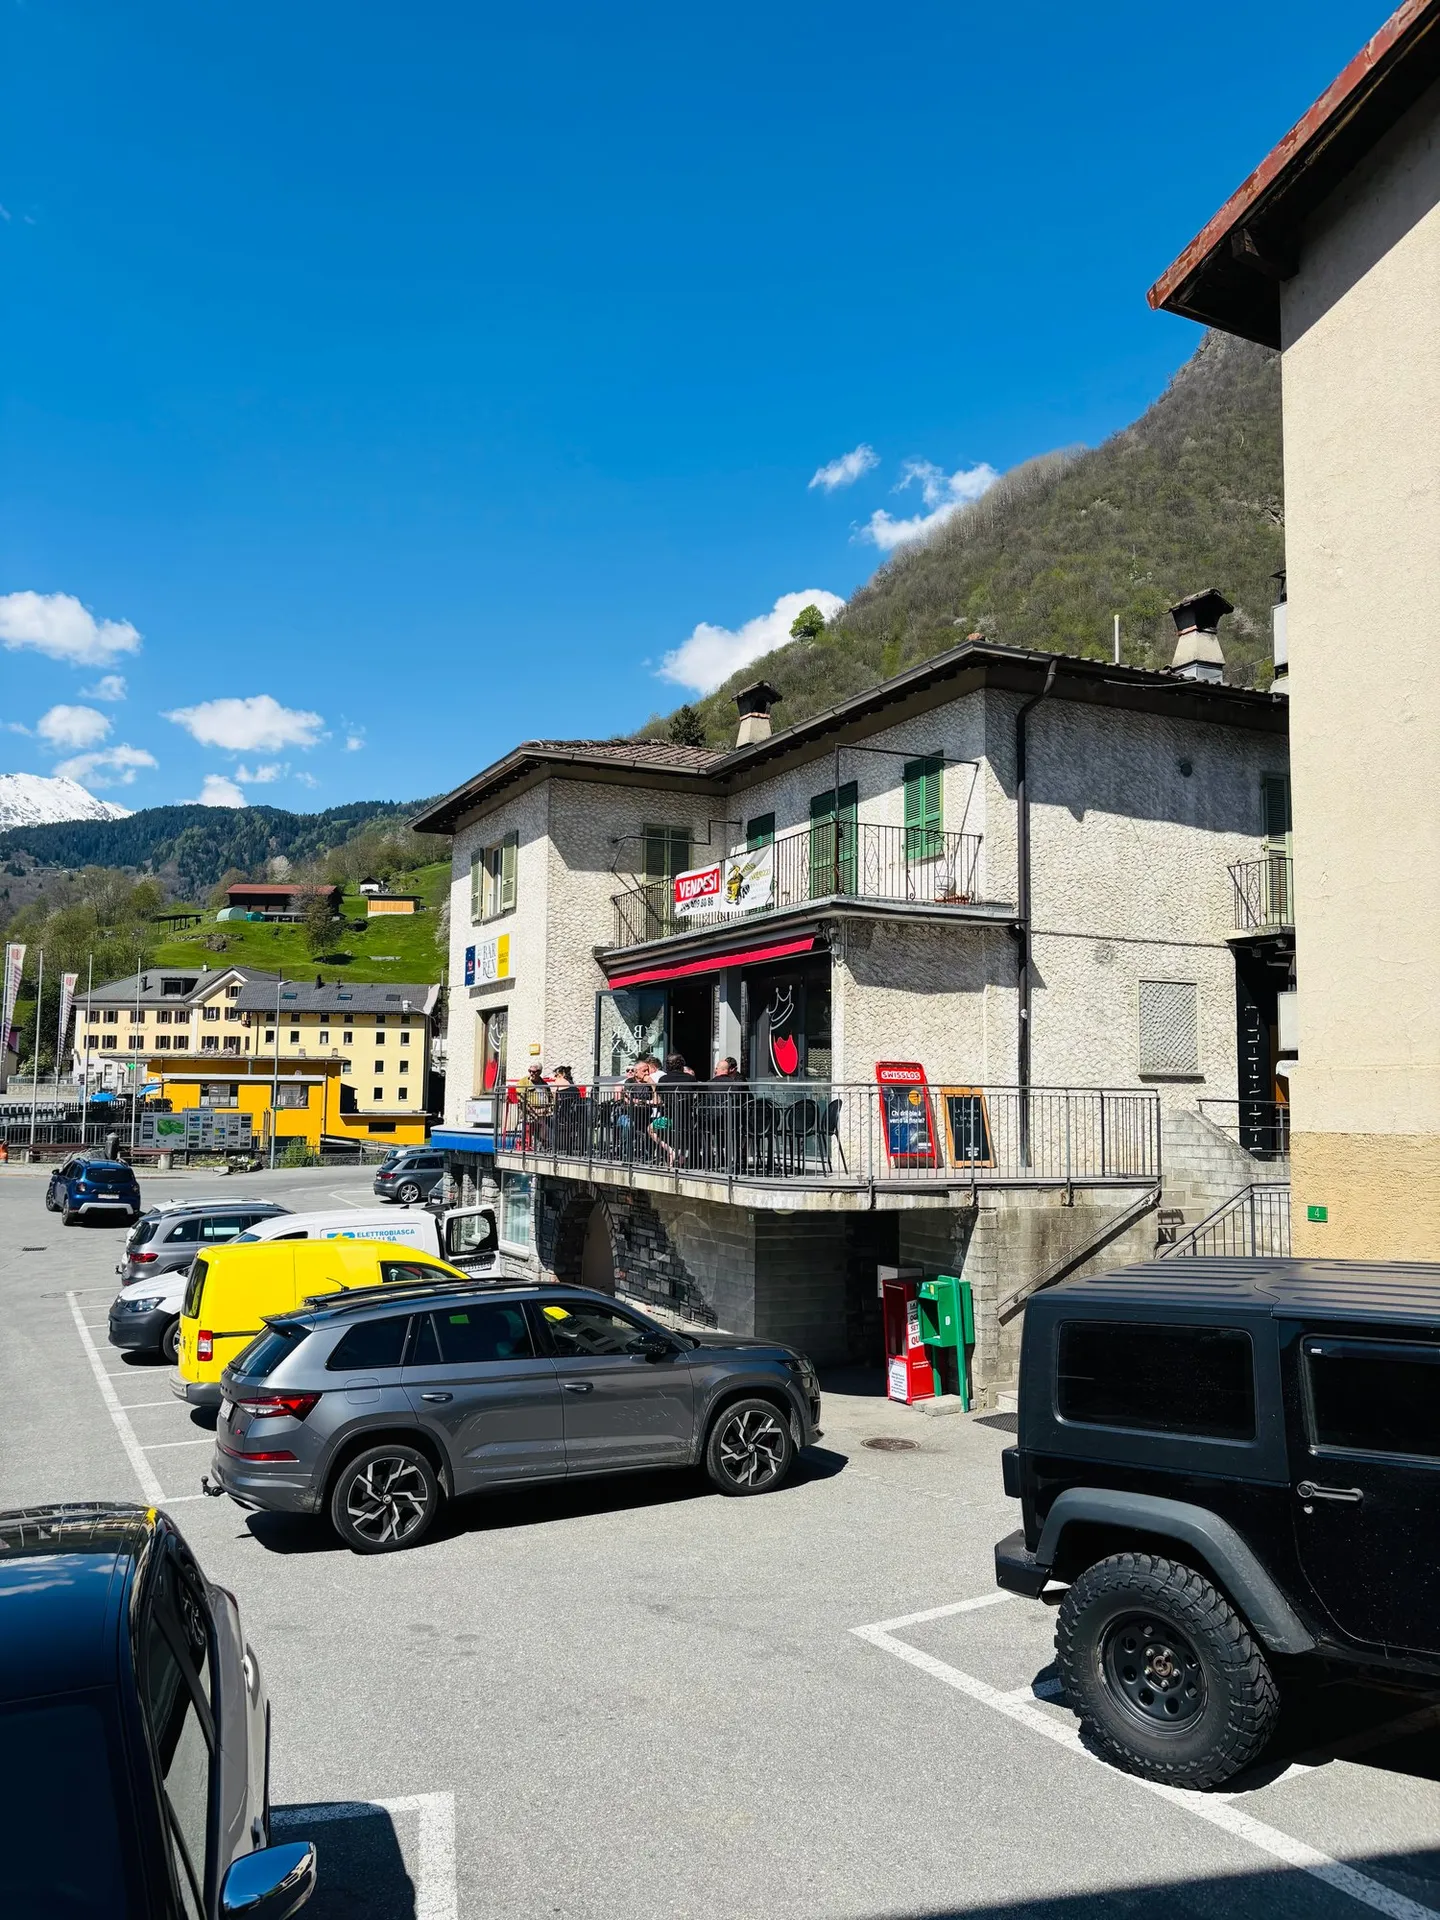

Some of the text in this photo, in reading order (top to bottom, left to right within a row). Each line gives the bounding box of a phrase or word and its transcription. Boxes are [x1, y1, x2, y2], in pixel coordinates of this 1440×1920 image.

[680, 873, 717, 898] VENDESI
[483, 942, 497, 961] BAR
[483, 958, 497, 978] REX
[1314, 1207, 1320, 1218] 4
[357, 1228, 415, 1239] ELETTROBIASCA
